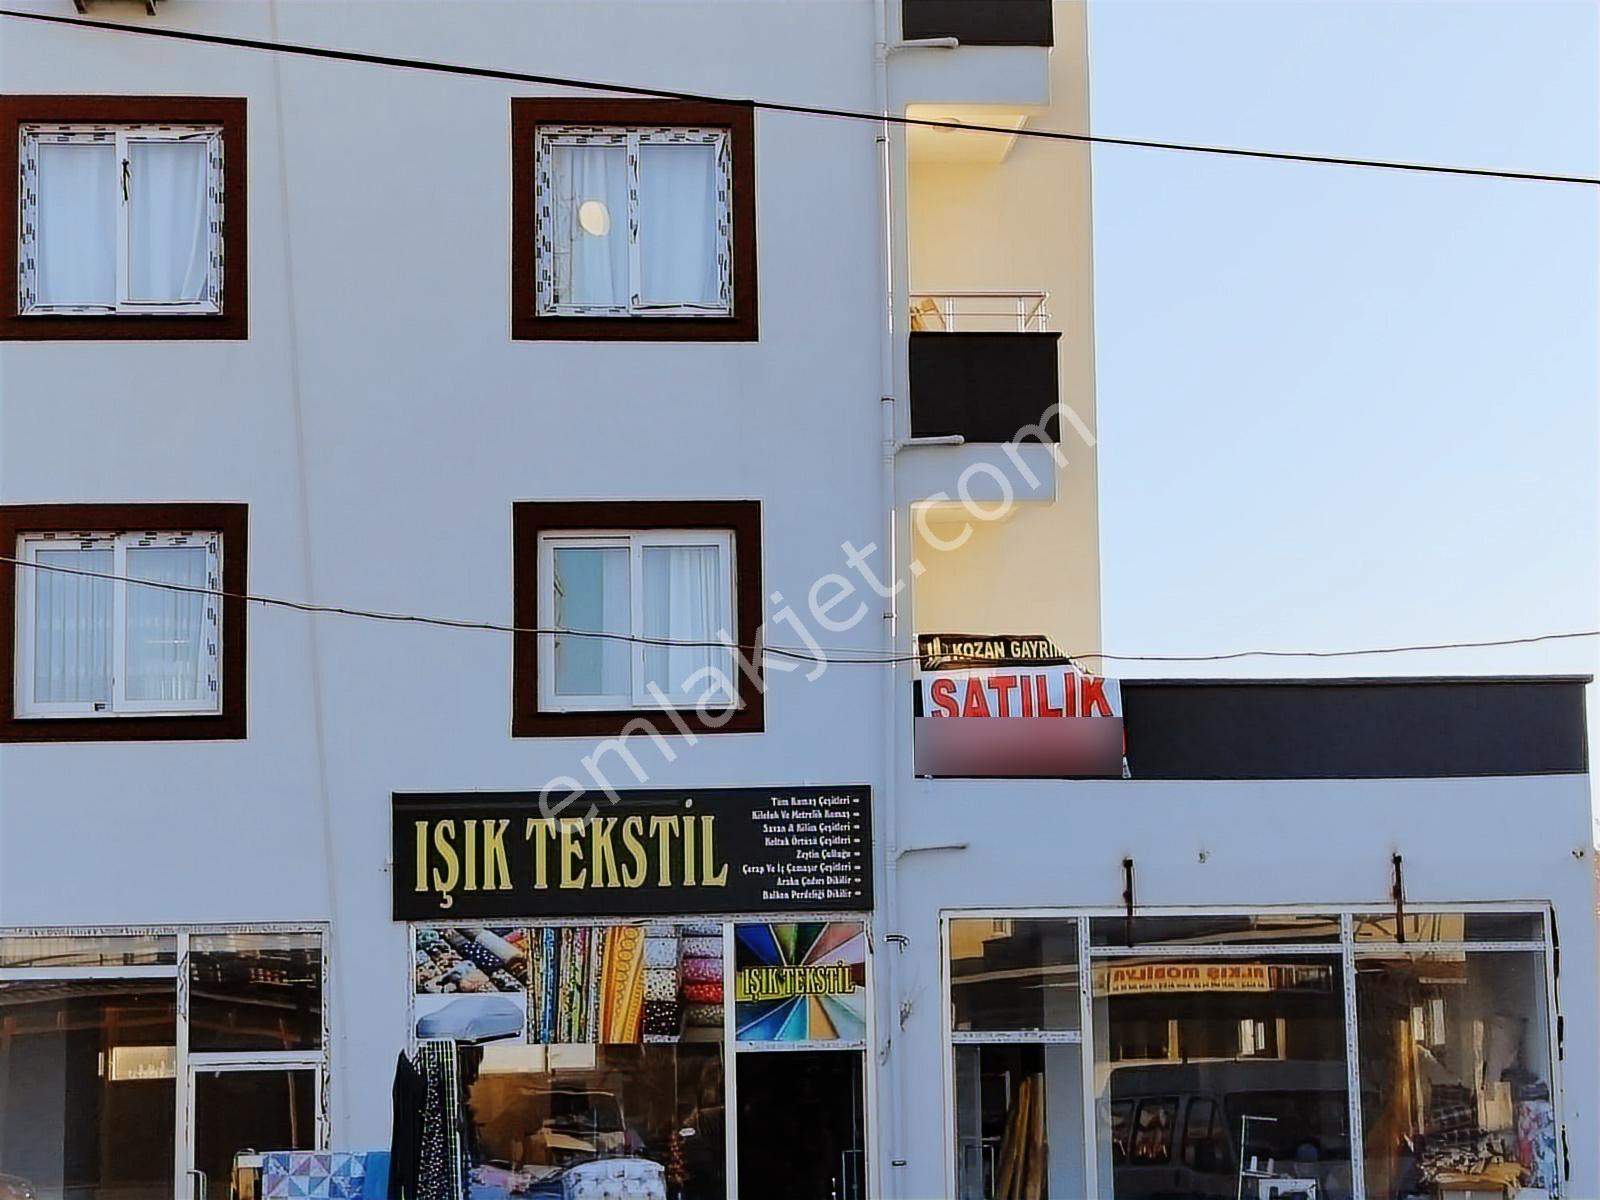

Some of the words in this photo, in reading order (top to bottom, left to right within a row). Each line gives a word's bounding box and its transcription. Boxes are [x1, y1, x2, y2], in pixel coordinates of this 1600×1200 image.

[952, 641, 1005, 661] KOZAN
[818, 795, 850, 807] Çeşitleri
[819, 822, 851, 834] Çeşitleri
[819, 835, 851, 846] Çeşitleri
[415, 819, 513, 909] IŞIK
[526, 797, 728, 889] TEKSTİL
[796, 850, 820, 860] Zeytin
[820, 862, 851, 874] Çeşitleri
[744, 967, 778, 1002] IŞIK
[783, 960, 856, 994] TEKSTİL
